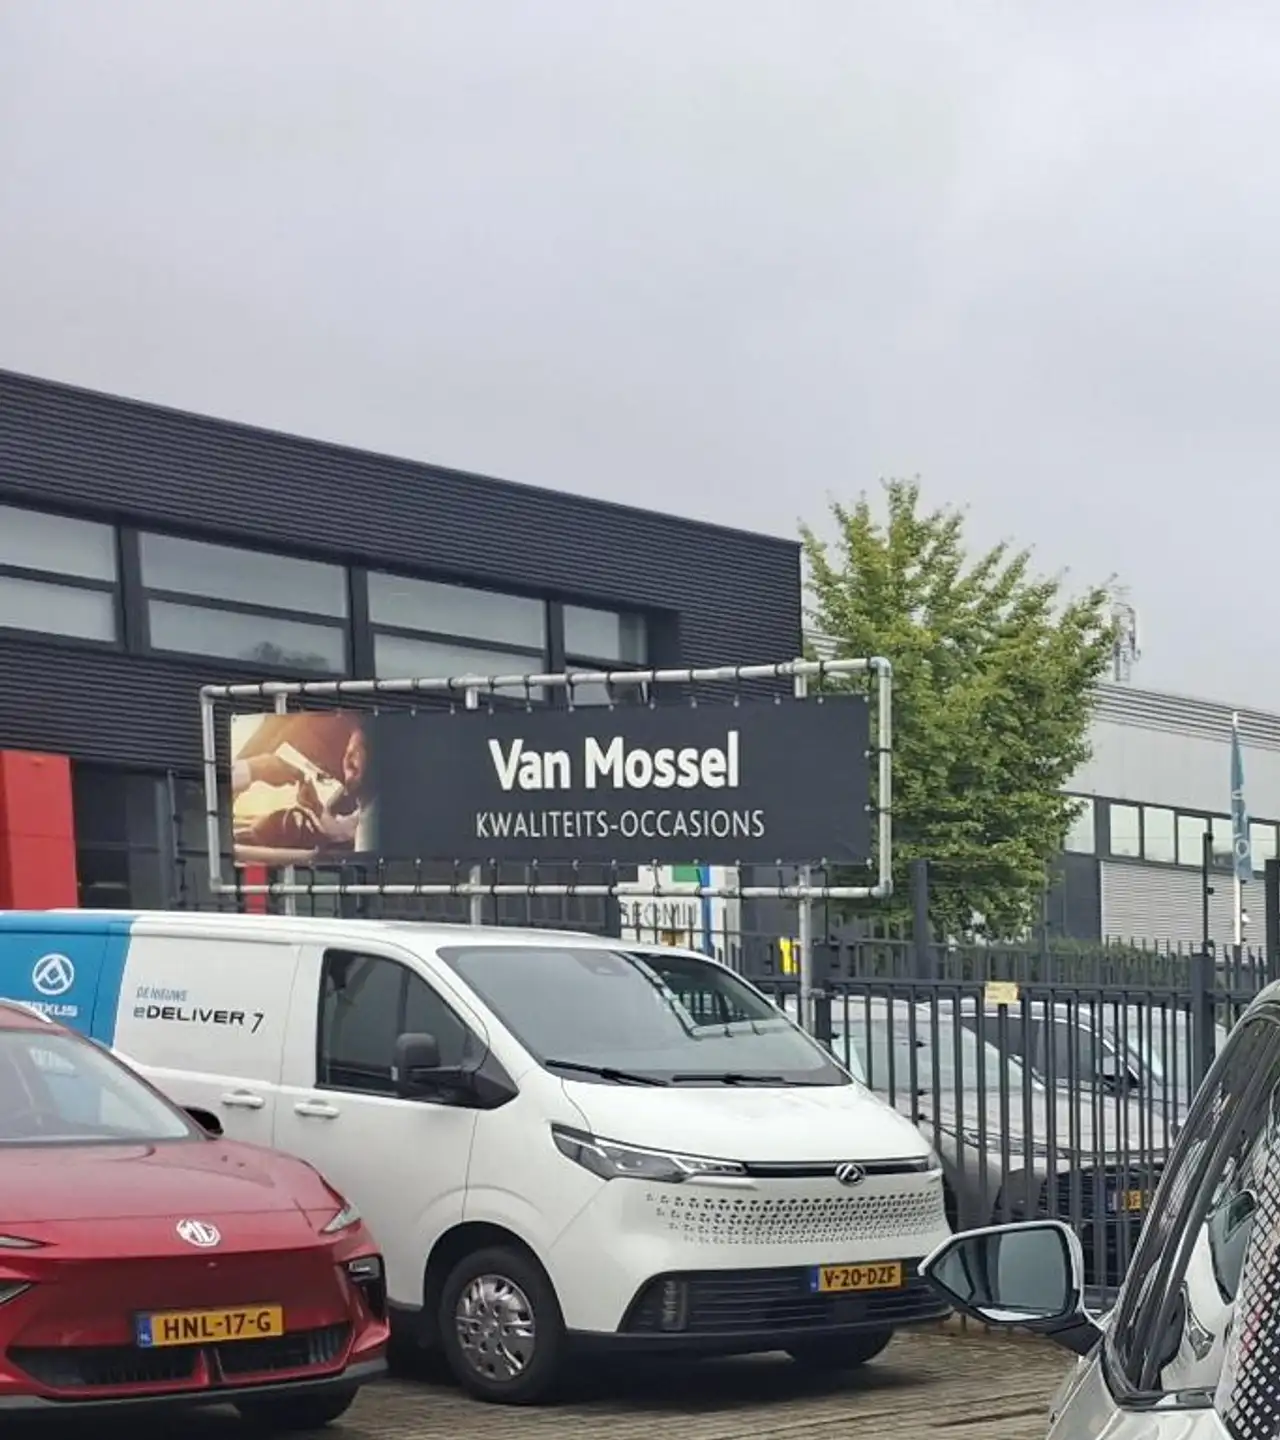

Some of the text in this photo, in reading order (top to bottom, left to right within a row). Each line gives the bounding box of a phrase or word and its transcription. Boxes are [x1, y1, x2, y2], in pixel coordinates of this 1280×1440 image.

[488, 731, 739, 790] Van Mossel
[476, 809, 765, 838] KWALITEITS-OCCASIONS
[133, 1005, 265, 1035] eDELIVER 7
[823, 1265, 897, 1289] V-20-DZF
[163, 1311, 272, 1341] HNL-17-G
